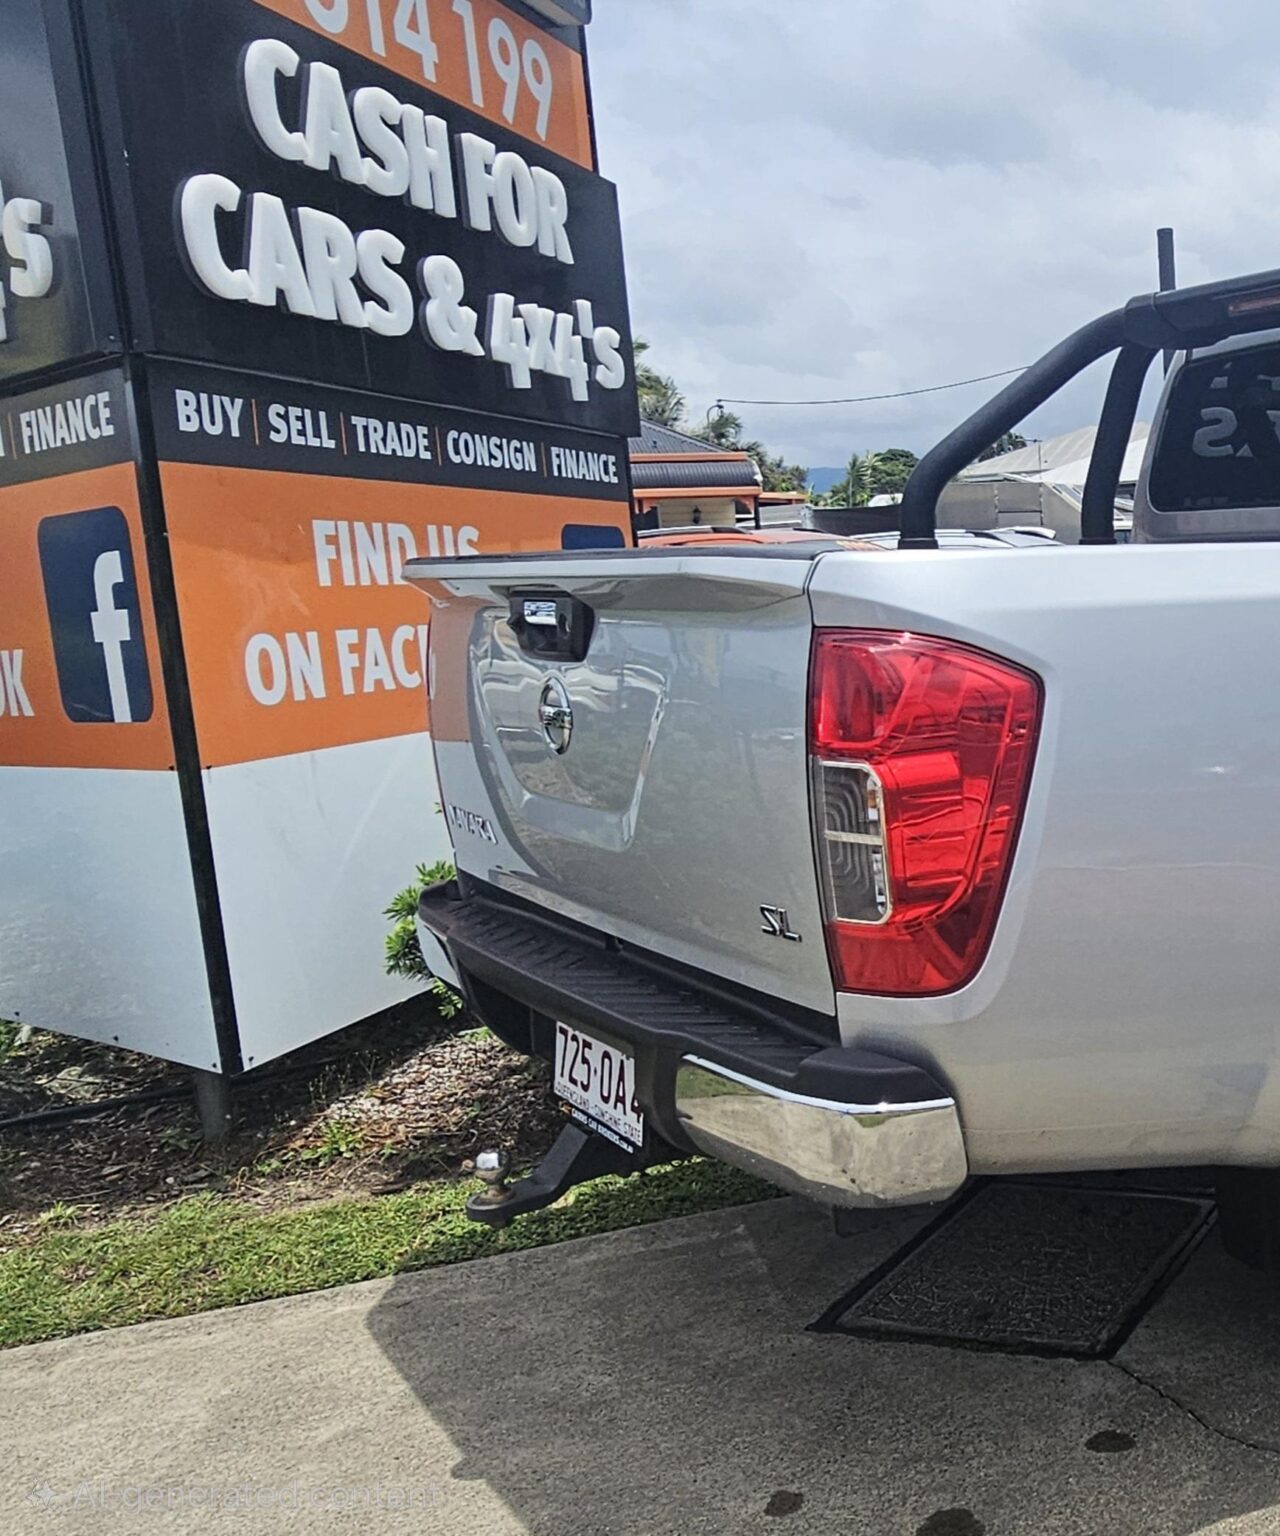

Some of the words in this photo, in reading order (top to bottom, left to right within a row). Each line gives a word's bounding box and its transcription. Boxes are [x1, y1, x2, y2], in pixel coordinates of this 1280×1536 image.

[453, 0, 551, 141] 199
[243, 38, 457, 218] CASH
[460, 133, 574, 264] FOR
[179, 173, 414, 337] CARS
[423, 254, 486, 356] &
[19, 391, 115, 455] FINANCE
[175, 389, 243, 437] BUY
[267, 403, 336, 449] SELL
[351, 415, 432, 460] TRADE
[446, 429, 537, 472] CONSIGN
[550, 446, 619, 483] FINANCE
[311, 519, 418, 586] FIND
[244, 631, 326, 706] ON
[759, 903, 802, 942] SL
